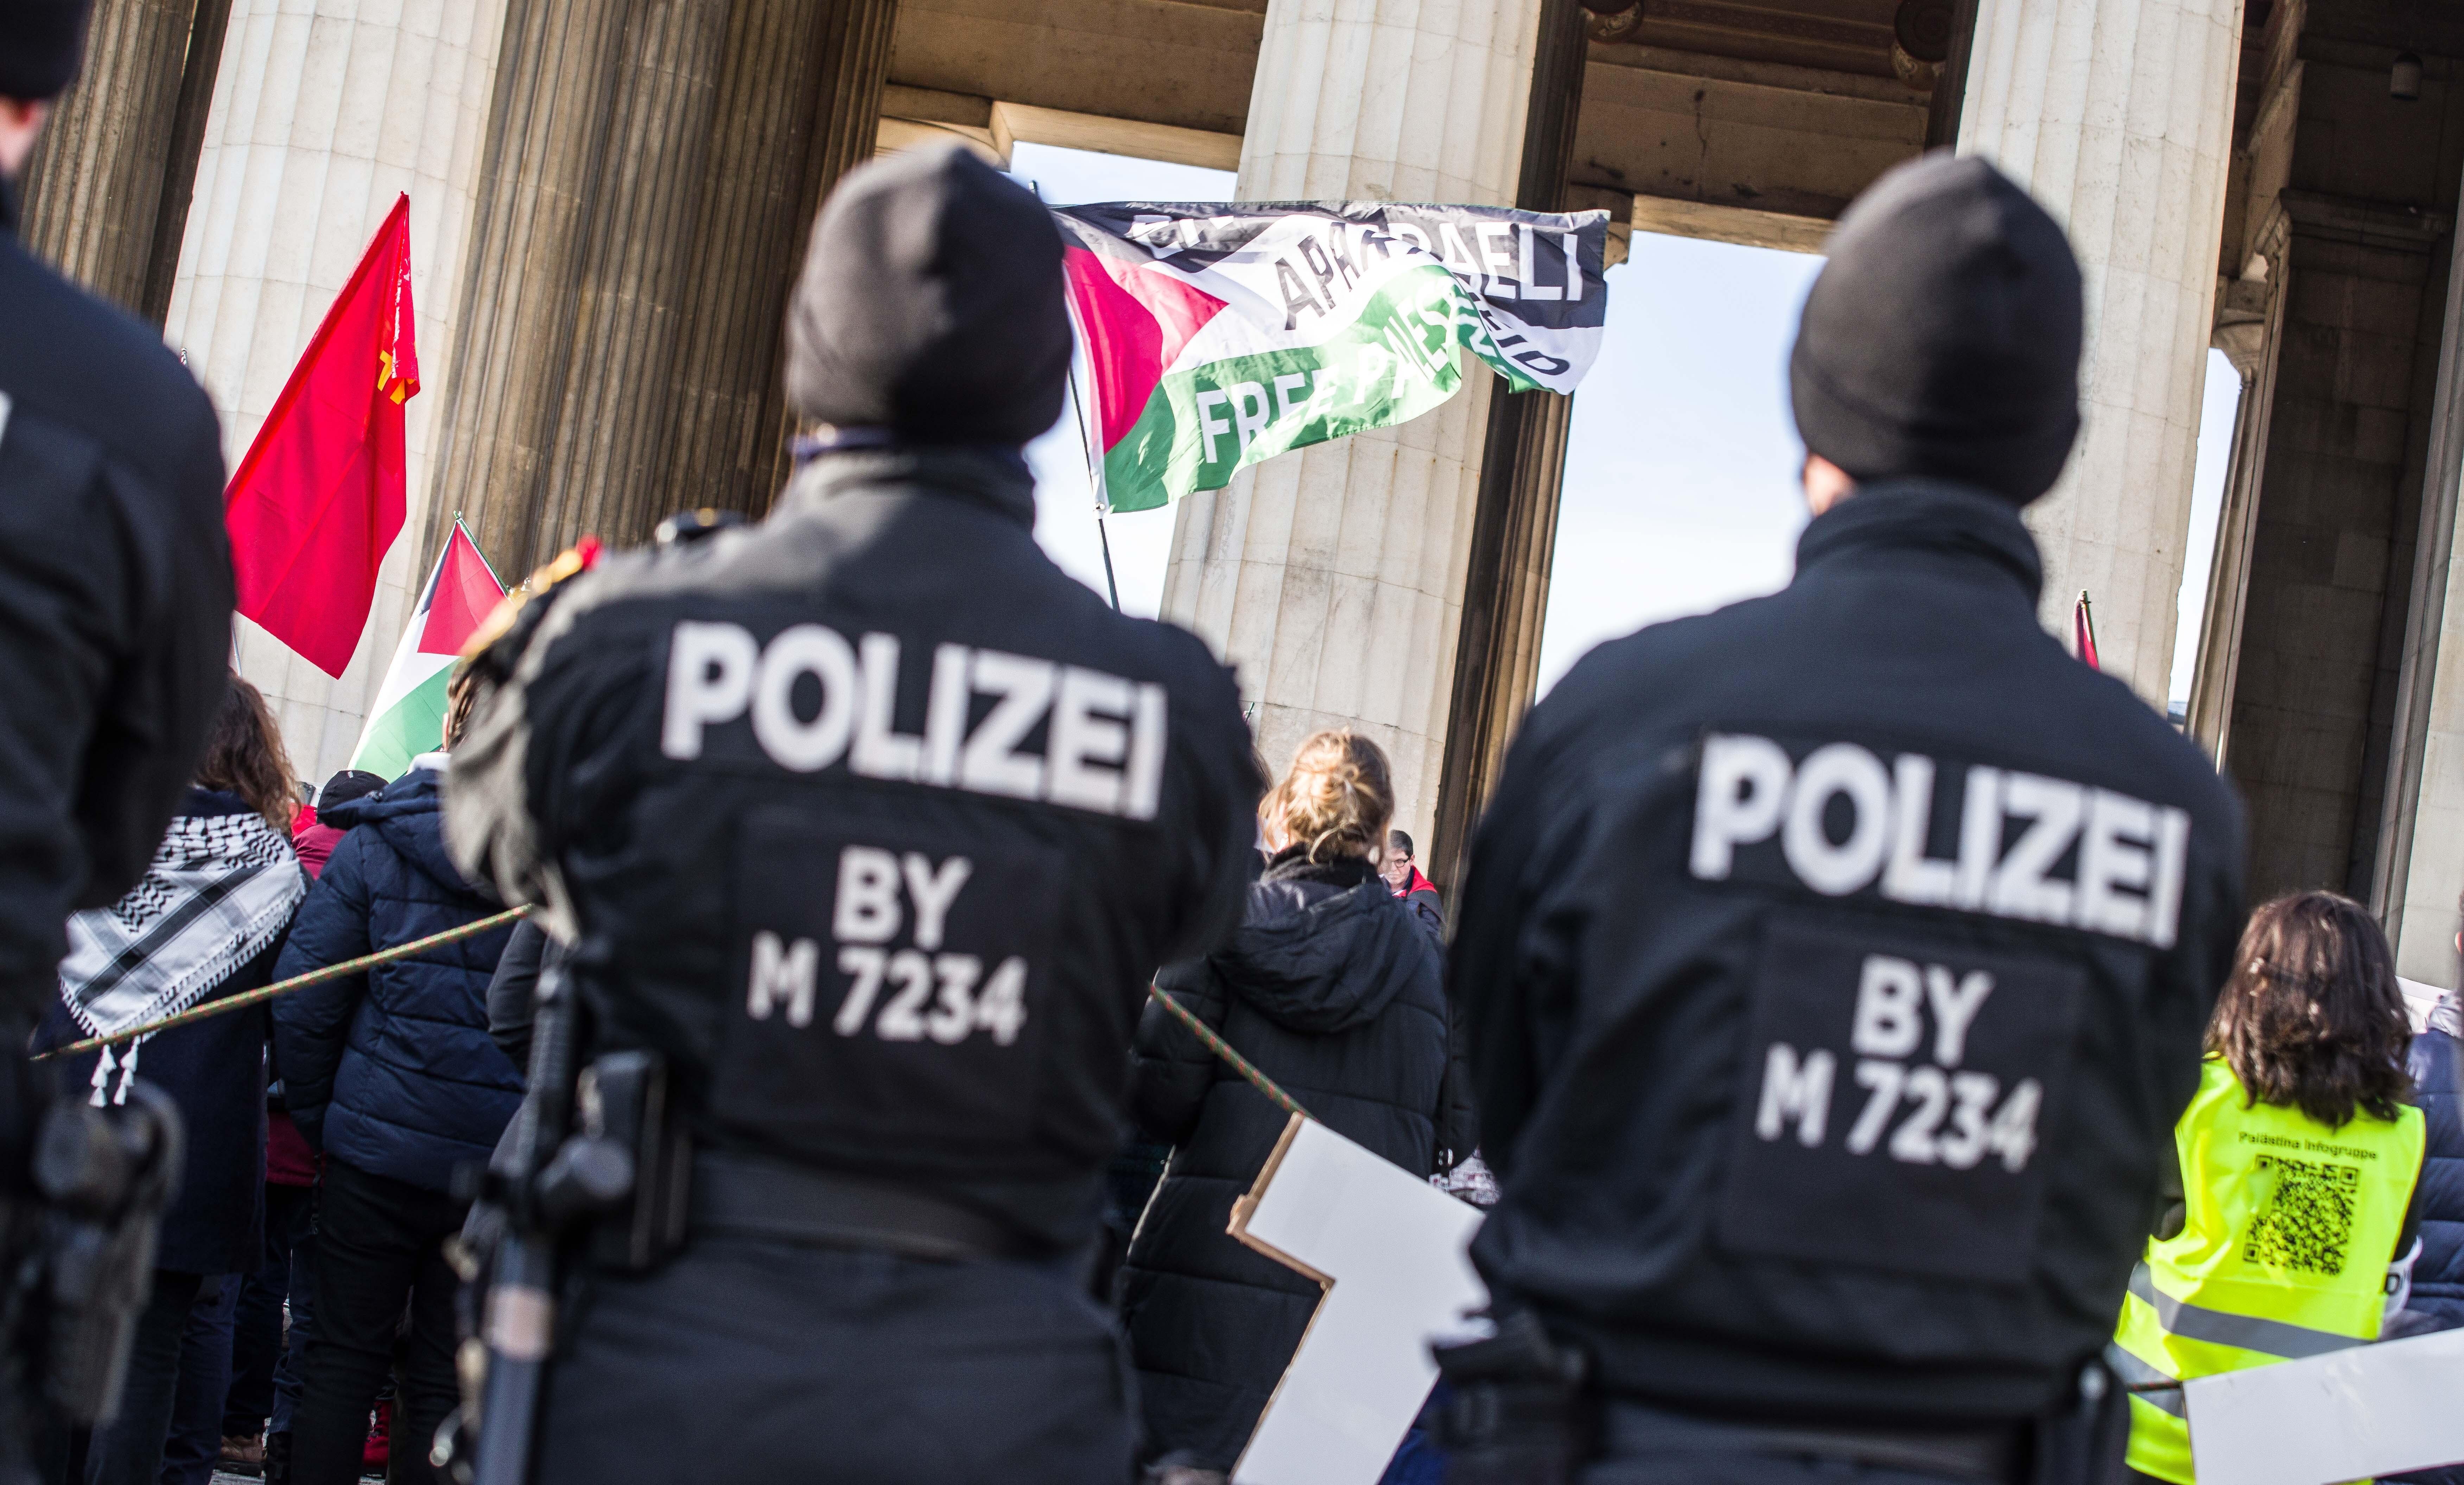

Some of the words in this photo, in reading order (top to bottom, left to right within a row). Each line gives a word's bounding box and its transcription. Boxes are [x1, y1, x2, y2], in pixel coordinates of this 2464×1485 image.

[1196, 363, 1338, 464] FREE
[661, 620, 1168, 820] POLIZEI
[833, 845, 973, 951] BY
[1690, 733, 2190, 949] POLIZEI
[747, 930, 819, 1028] M
[834, 945, 1027, 1046] 7234
[1851, 954, 1995, 1066] BY
[1757, 1043, 1836, 1147] M
[1846, 1059, 2042, 1172] 7234
[2239, 1131, 2299, 1149] Palästina
[2304, 1139, 2377, 1160] Infogruppe
